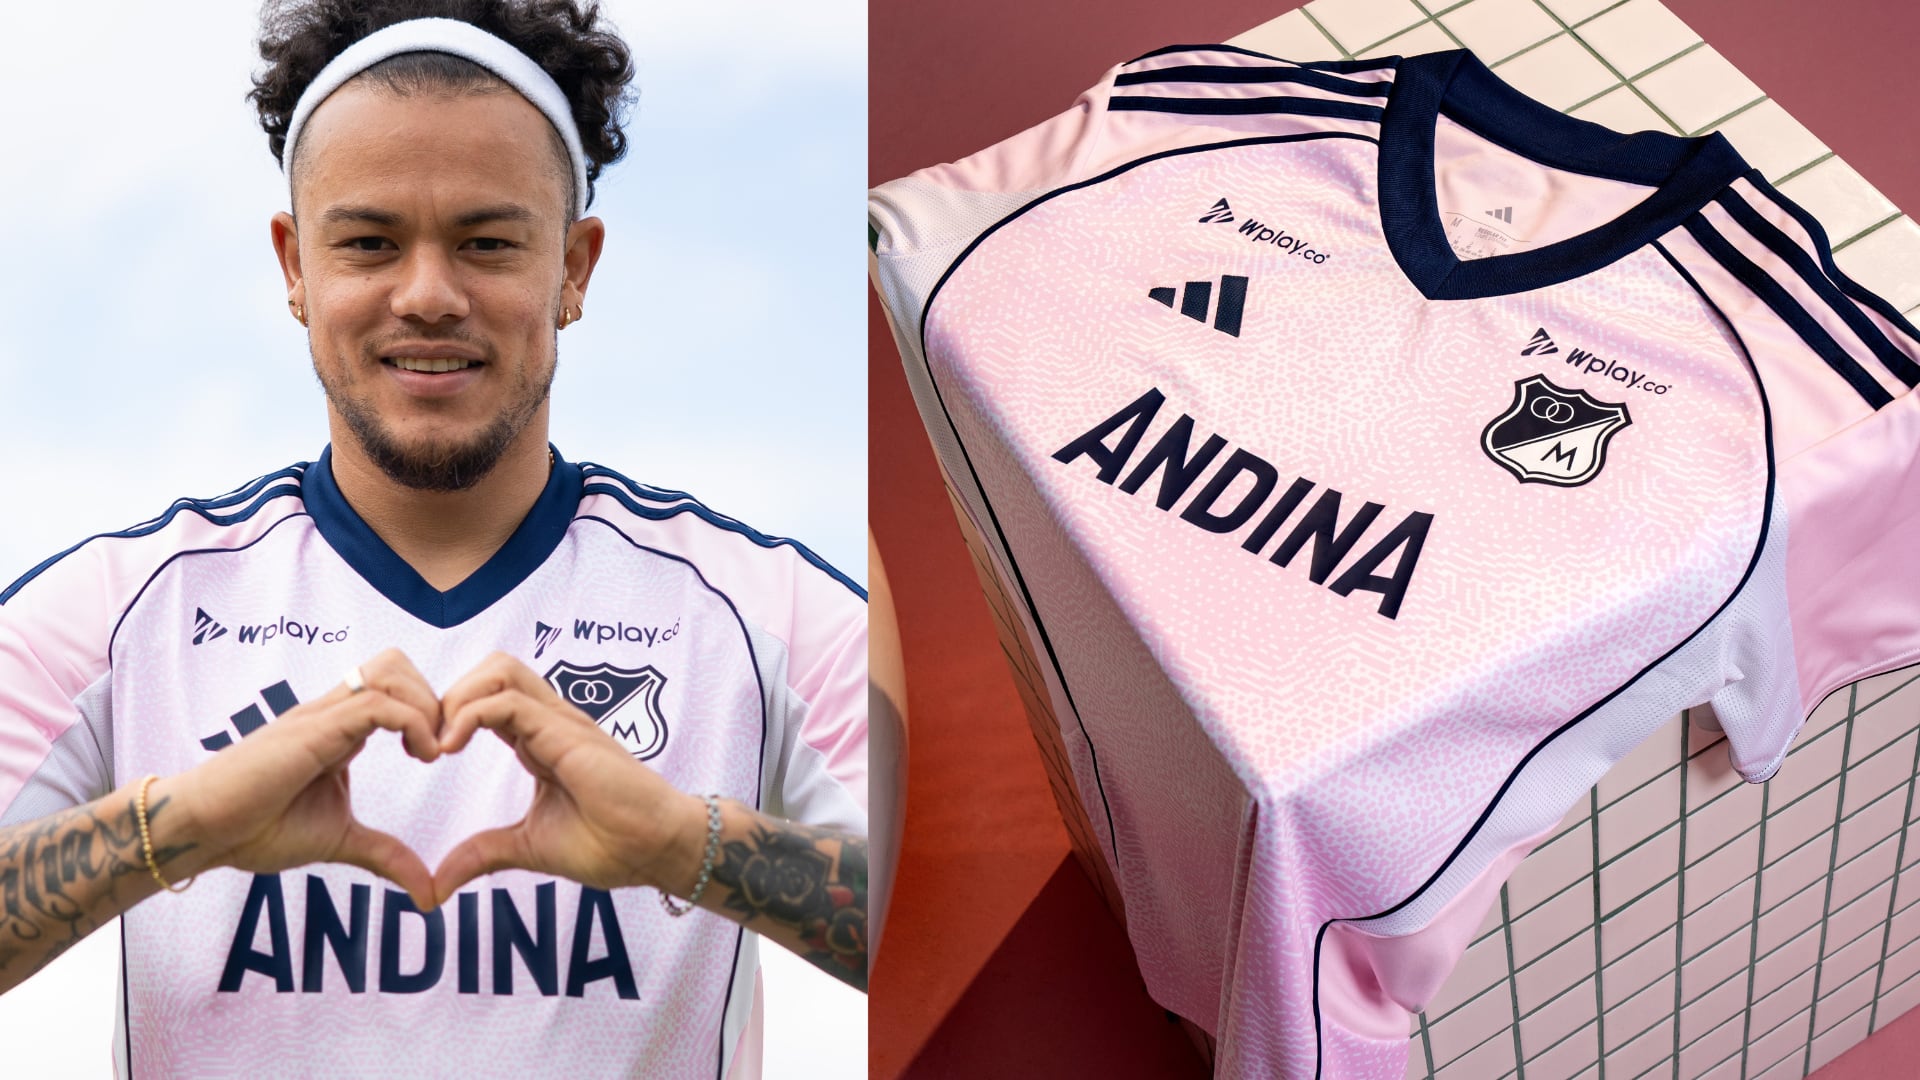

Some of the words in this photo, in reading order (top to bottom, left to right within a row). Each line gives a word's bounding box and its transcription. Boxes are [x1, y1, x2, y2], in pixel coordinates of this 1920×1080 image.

[1540, 440, 1578, 471] M
[1051, 386, 1435, 621] ANDINA
[611, 720, 641, 744] M
[217, 872, 641, 1000] ANDINA
